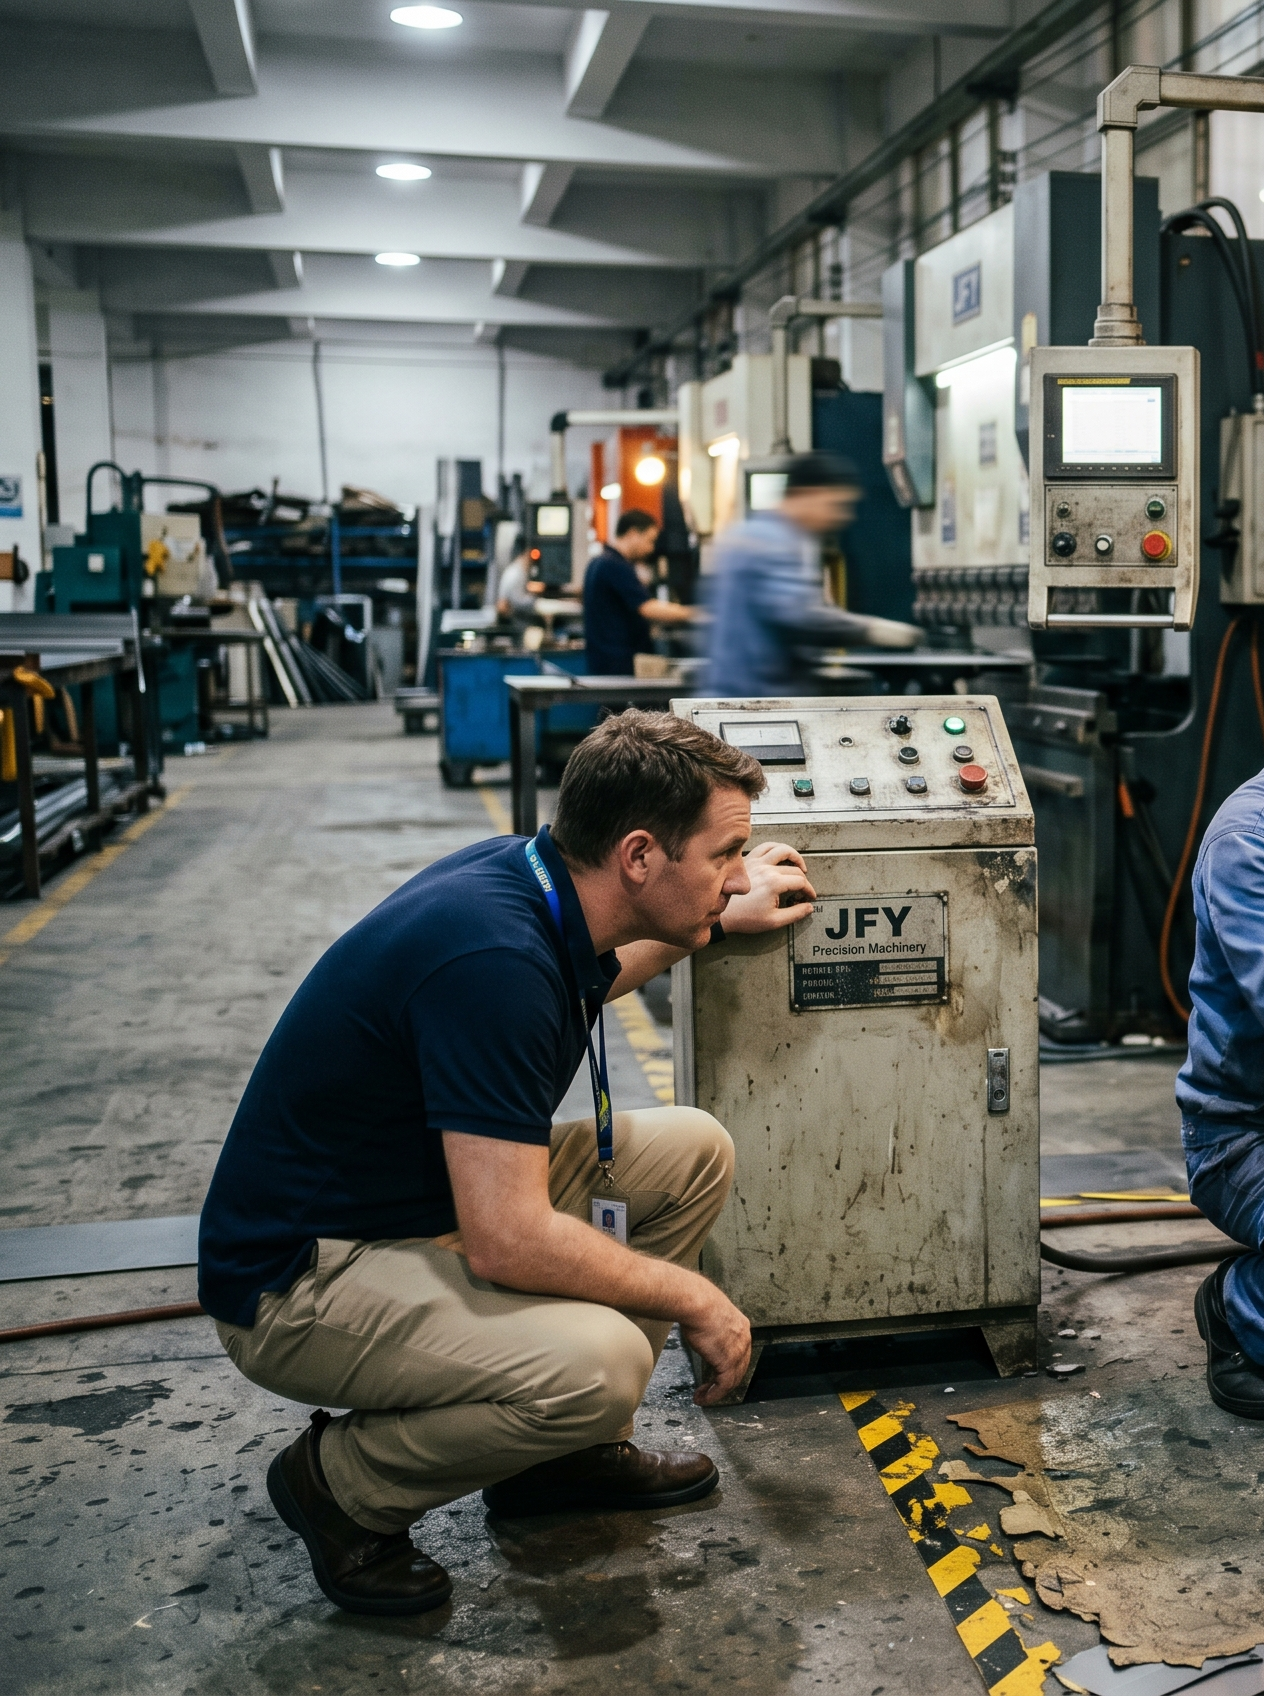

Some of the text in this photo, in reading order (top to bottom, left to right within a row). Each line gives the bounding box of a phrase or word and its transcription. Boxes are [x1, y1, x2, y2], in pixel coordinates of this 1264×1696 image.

[825, 906, 912, 940] JFY
[812, 942, 927, 956] Precision Machinery
